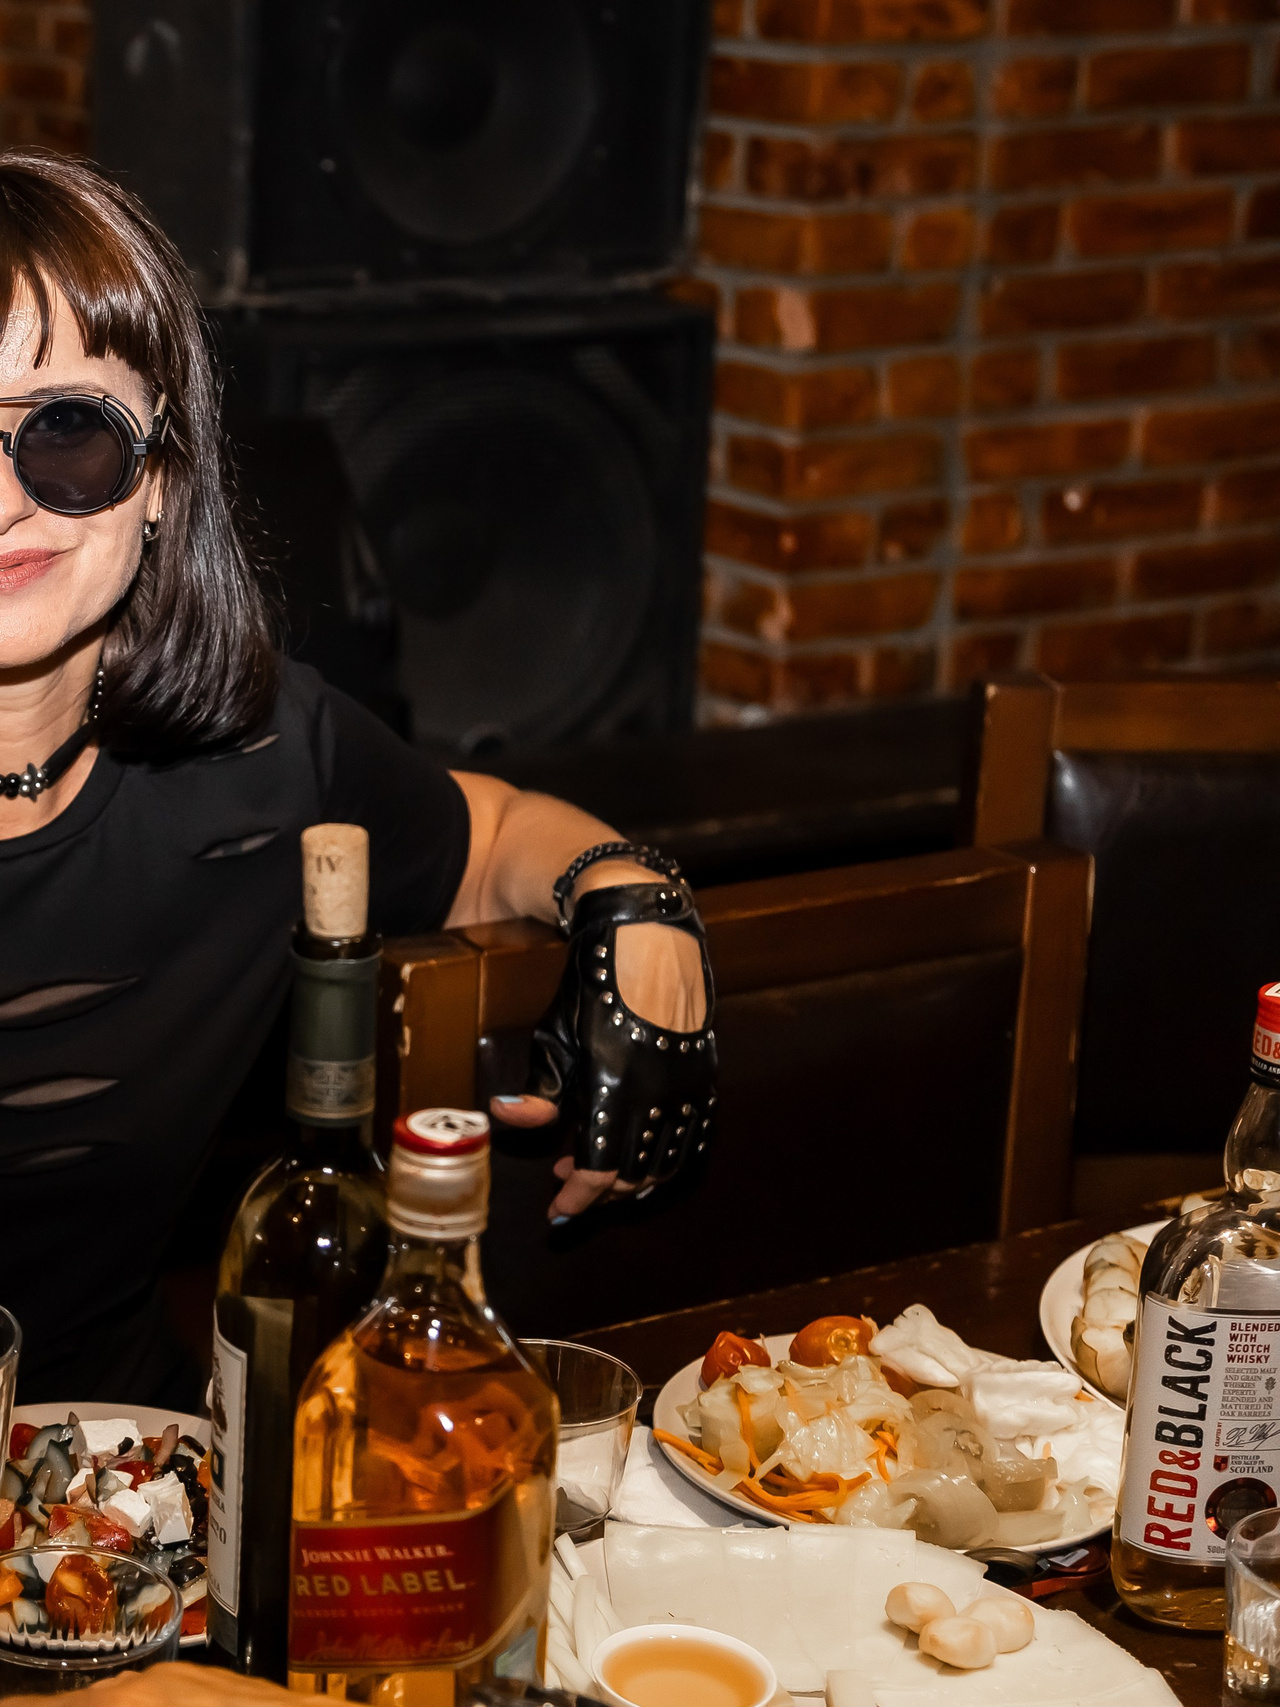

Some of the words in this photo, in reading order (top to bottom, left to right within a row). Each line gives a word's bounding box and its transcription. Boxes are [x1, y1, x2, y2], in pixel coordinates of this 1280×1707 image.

[1230, 1322, 1280, 1332] BLENDED
[1229, 1333, 1257, 1342] WITH
[1228, 1344, 1270, 1353] SCOTCH
[1227, 1354, 1270, 1364] WHISKY
[1144, 1315, 1217, 1551] RED&BLACK
[1229, 1465, 1274, 1473] SCOTLAND
[295, 1574, 352, 1597] RED
[360, 1569, 466, 1596] LABEL
